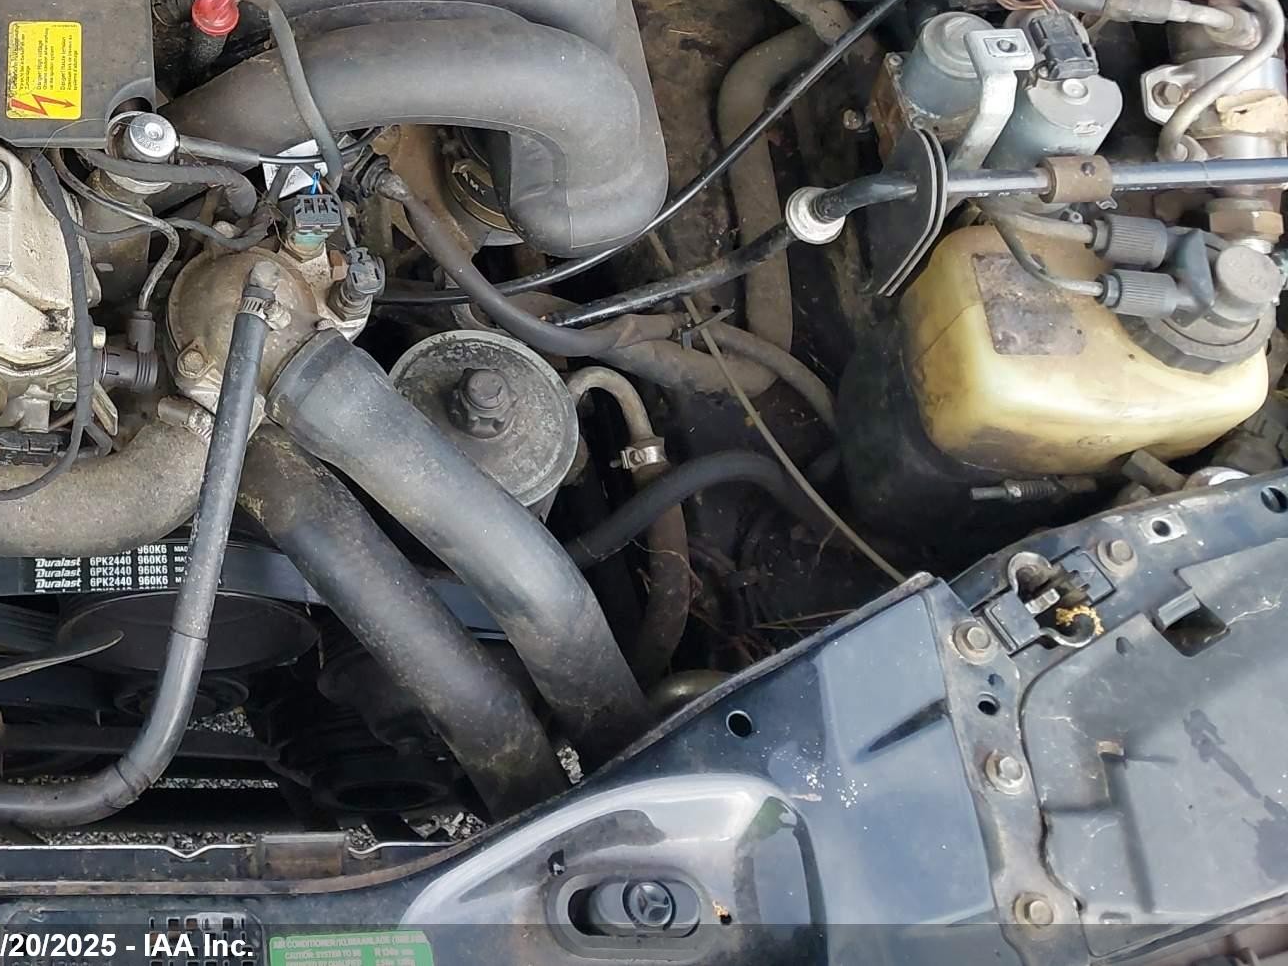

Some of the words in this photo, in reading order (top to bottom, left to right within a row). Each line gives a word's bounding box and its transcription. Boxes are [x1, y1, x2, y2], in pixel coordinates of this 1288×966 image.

[34, 558, 81, 568] Duralast
[90, 556, 131, 566] 6PK2440
[137, 555, 168, 565] 960K6
[34, 568, 82, 578] Duralast
[90, 566, 132, 576] 6PK2440
[138, 565, 168, 575] 960K6
[35, 578, 82, 589] Duralast
[90, 576, 132, 587] 6PK2440
[138, 575, 169, 586] 960K6
